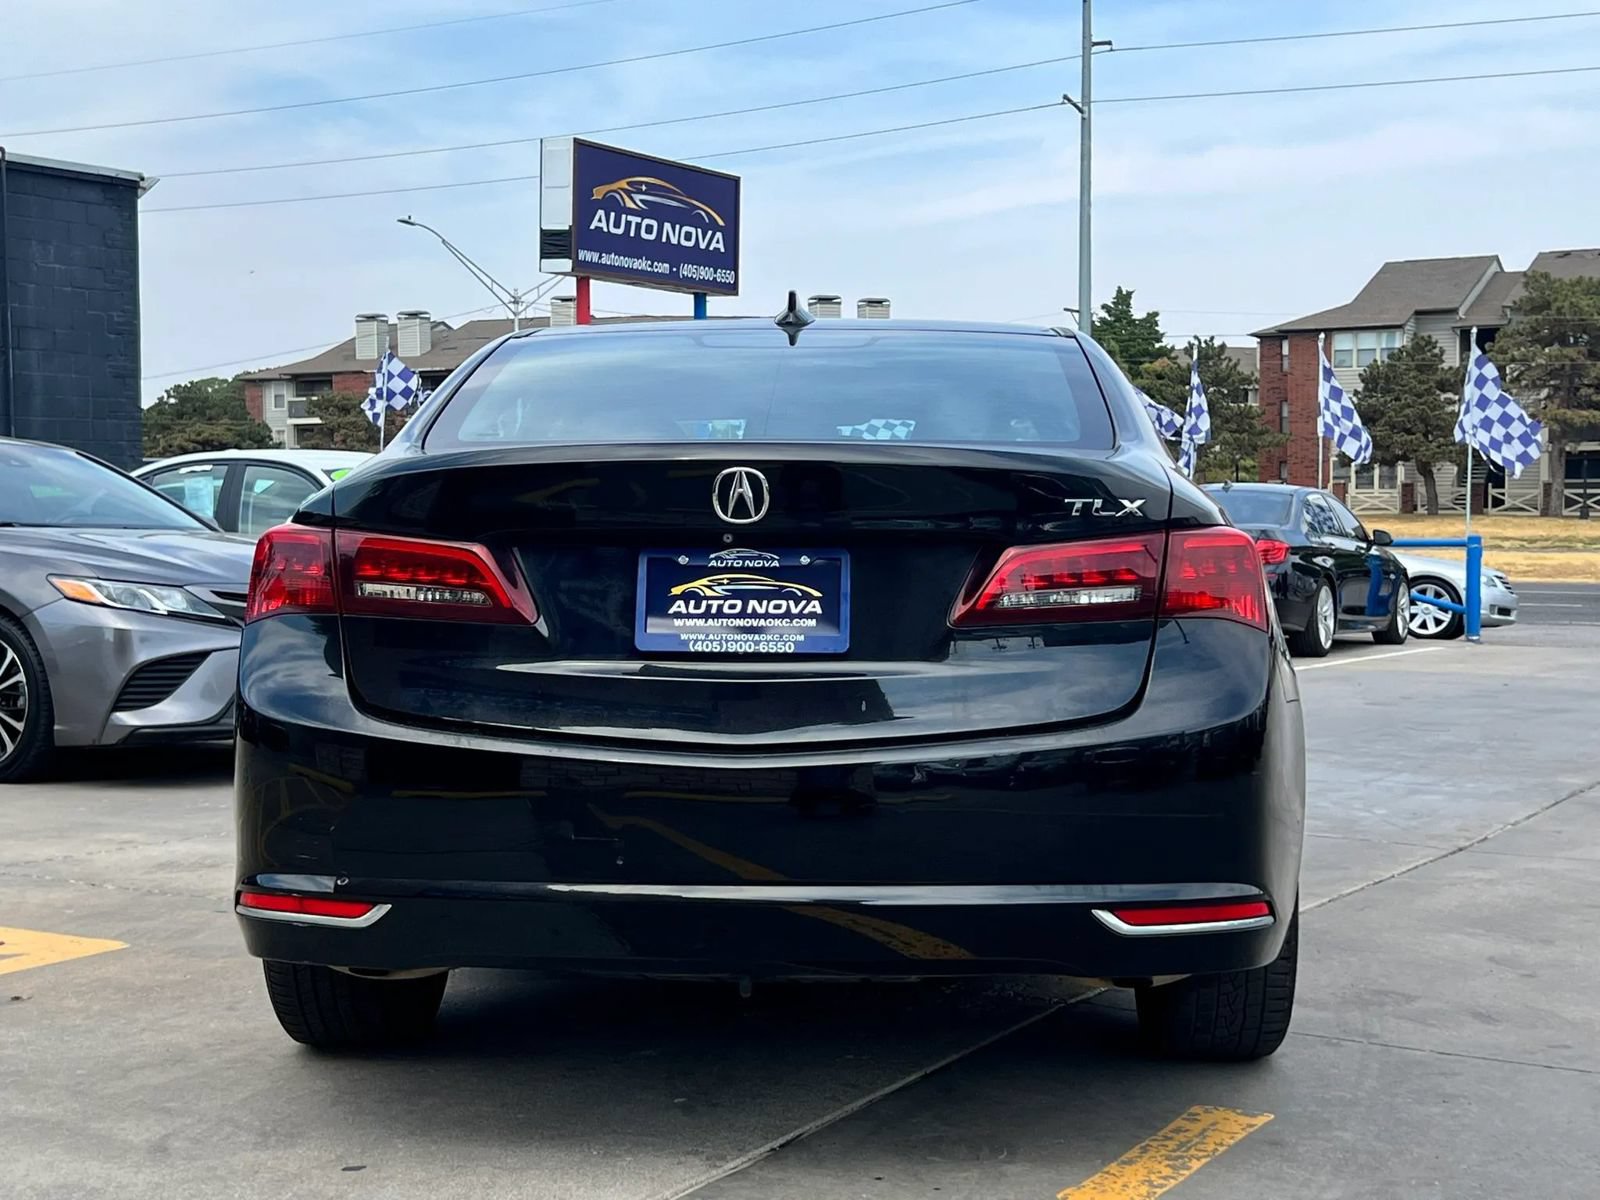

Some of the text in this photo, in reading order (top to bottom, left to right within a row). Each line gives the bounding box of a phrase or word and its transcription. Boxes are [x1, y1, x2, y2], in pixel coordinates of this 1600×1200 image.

[589, 209, 725, 252] AUTO NOVA
[578, 248, 669, 274] www.autonovaokc.com
[679, 262, 735, 284] (405)900-6550
[1064, 499, 1146, 517] TLX
[668, 600, 822, 614] AUTO NOVA
[673, 618, 816, 627] WWW.AUTONOVAOKC.COM
[680, 633, 805, 642] WWW.AUTONOVAOKC.COM
[689, 641, 795, 653] (405)900-6550
